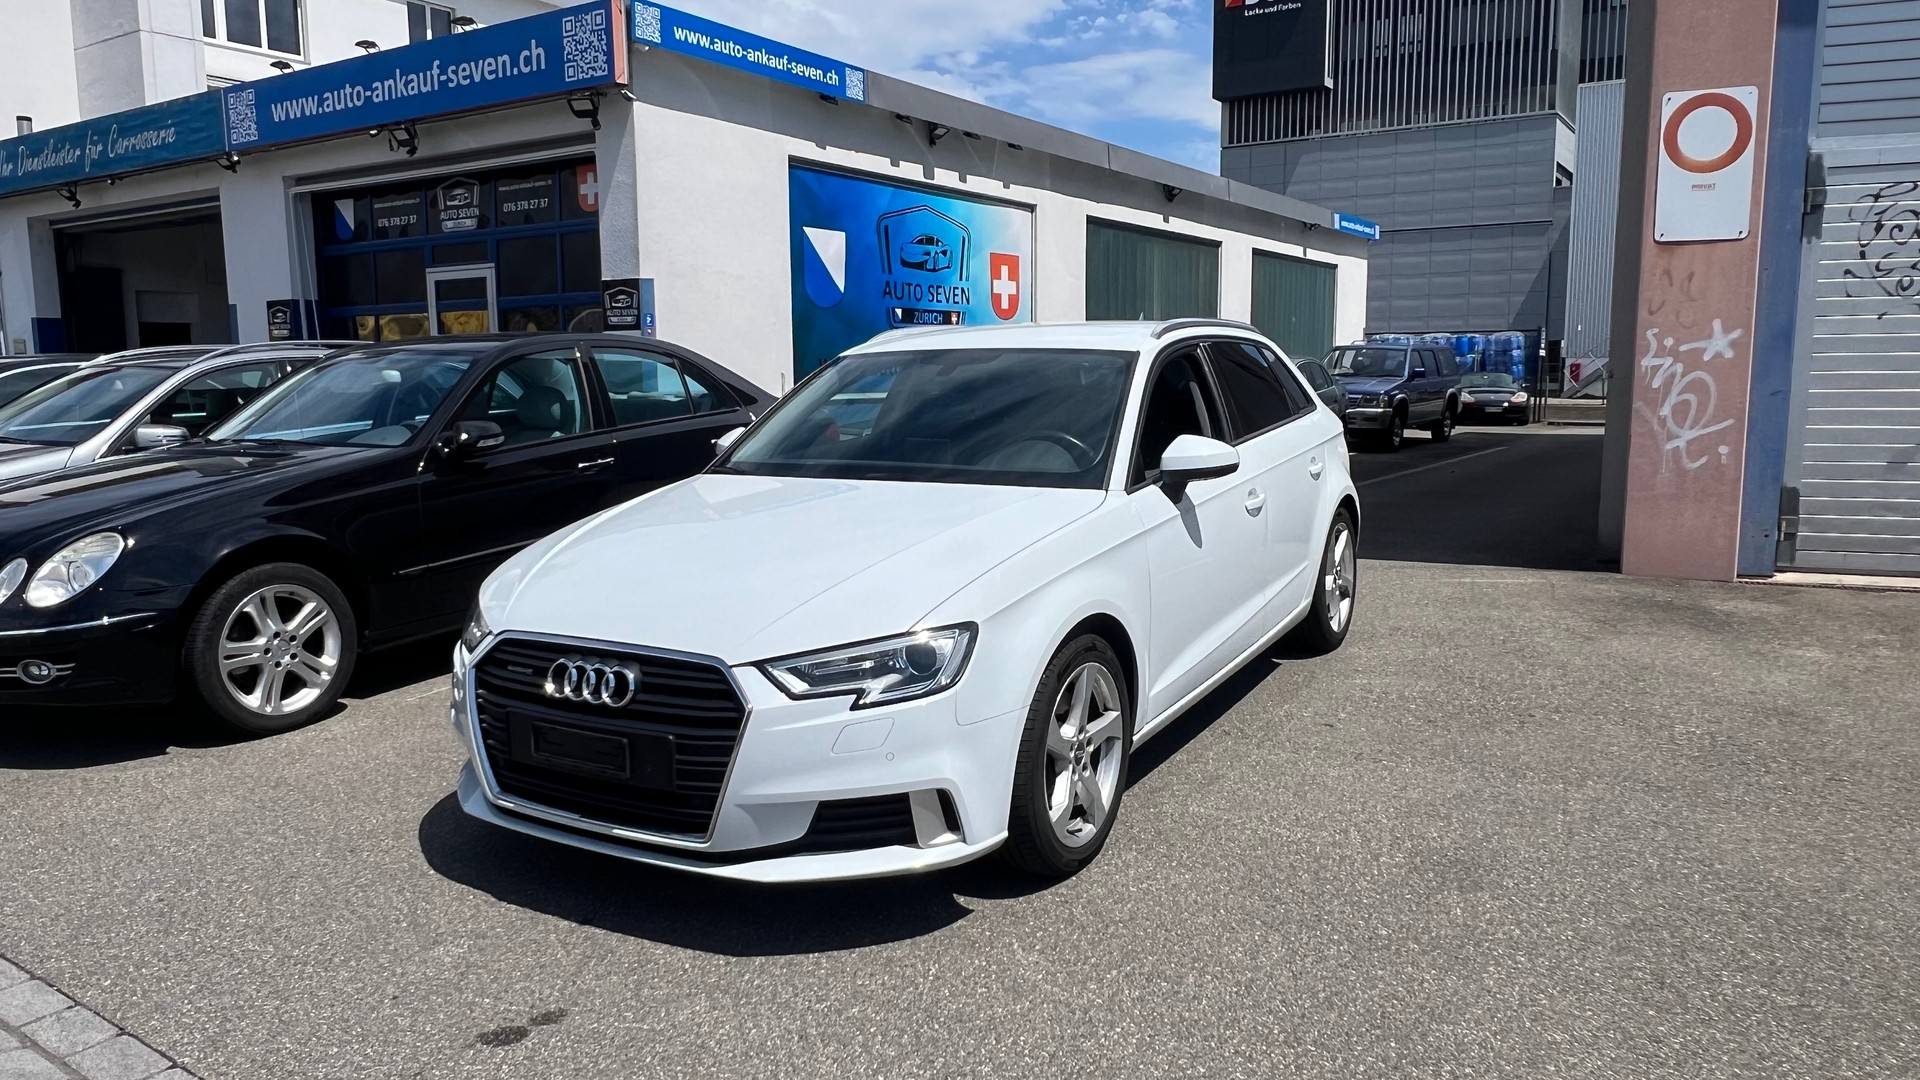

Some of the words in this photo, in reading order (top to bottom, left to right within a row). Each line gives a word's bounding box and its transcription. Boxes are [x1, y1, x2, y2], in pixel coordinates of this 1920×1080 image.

[1264, 5, 1277, 13] und
[673, 26, 839, 87] www.auto-ankauf-seven.ch
[271, 39, 546, 123] www.auto-ankauf-seven.ch
[18, 138, 81, 176] Dienstleister
[85, 130, 104, 172] für
[108, 120, 177, 158] Carrosserie
[440, 209, 458, 220] AUTO
[459, 207, 479, 218] SEVEN
[530, 199, 539, 209] 27
[539, 198, 548, 208] 37
[882, 280, 923, 302] AUTO
[928, 285, 970, 305] SEVEN
[913, 309, 943, 325] ZÜRICH
